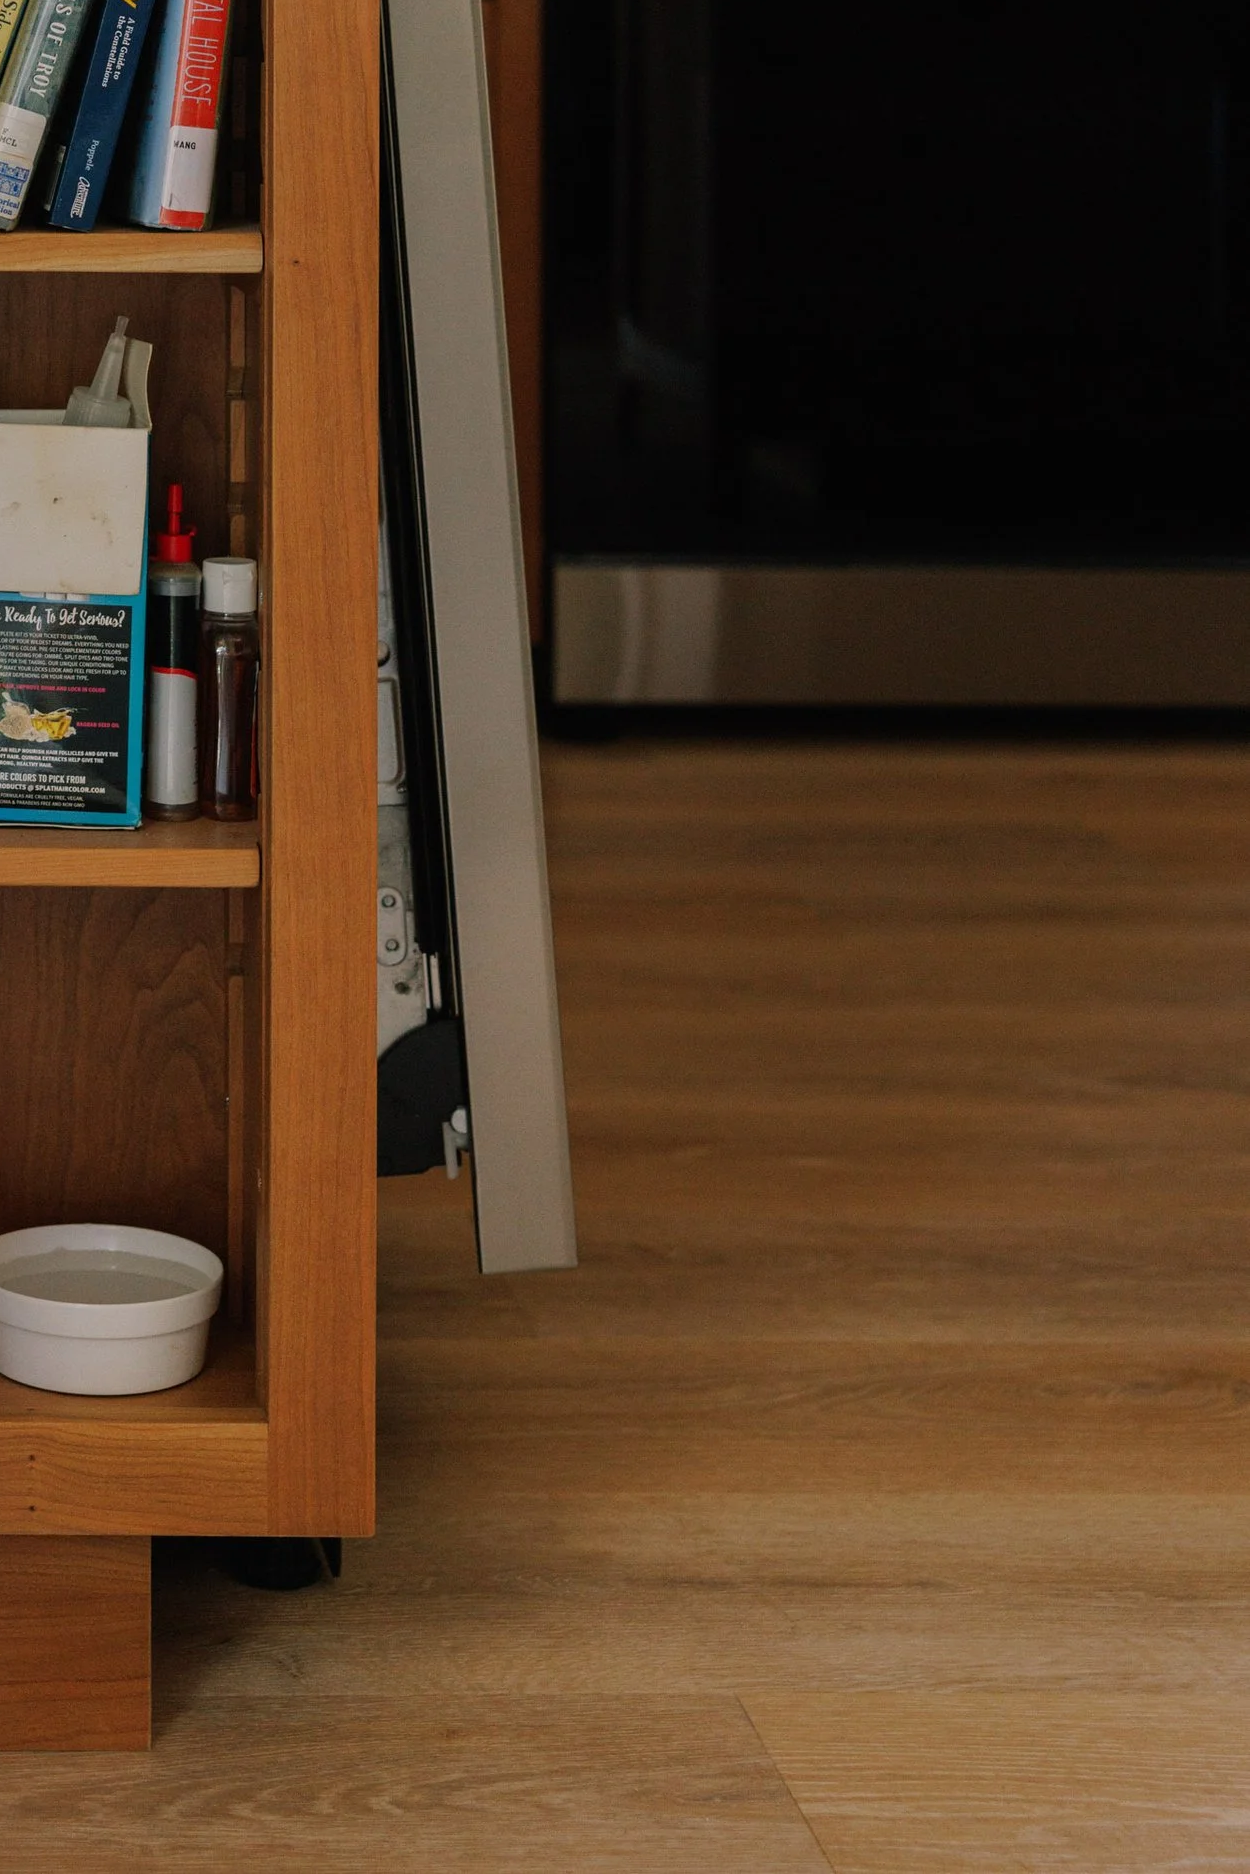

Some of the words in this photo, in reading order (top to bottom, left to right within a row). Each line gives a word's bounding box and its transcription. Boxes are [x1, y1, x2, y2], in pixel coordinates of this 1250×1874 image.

[49, 21, 68, 46] OF
[124, 26, 133, 44] Field
[102, 30, 123, 88] Constellations
[117, 44, 129, 70] Guide
[30, 52, 58, 99] TROY
[113, 70, 120, 80] to
[181, 38, 218, 106] HOUSE
[85, 139, 100, 171] Poppele
[173, 141, 196, 150] WANG
[4, 605, 42, 631] Ready
[44, 608, 56, 624] To
[79, 609, 126, 628] Serious?
[10, 772, 37, 782] COLORS
[38, 774, 47, 783] TO
[48, 775, 65, 784] PICK
[66, 775, 86, 785] FROM
[35, 785, 106, 794] SPLATHAIRCOLOR.COM
